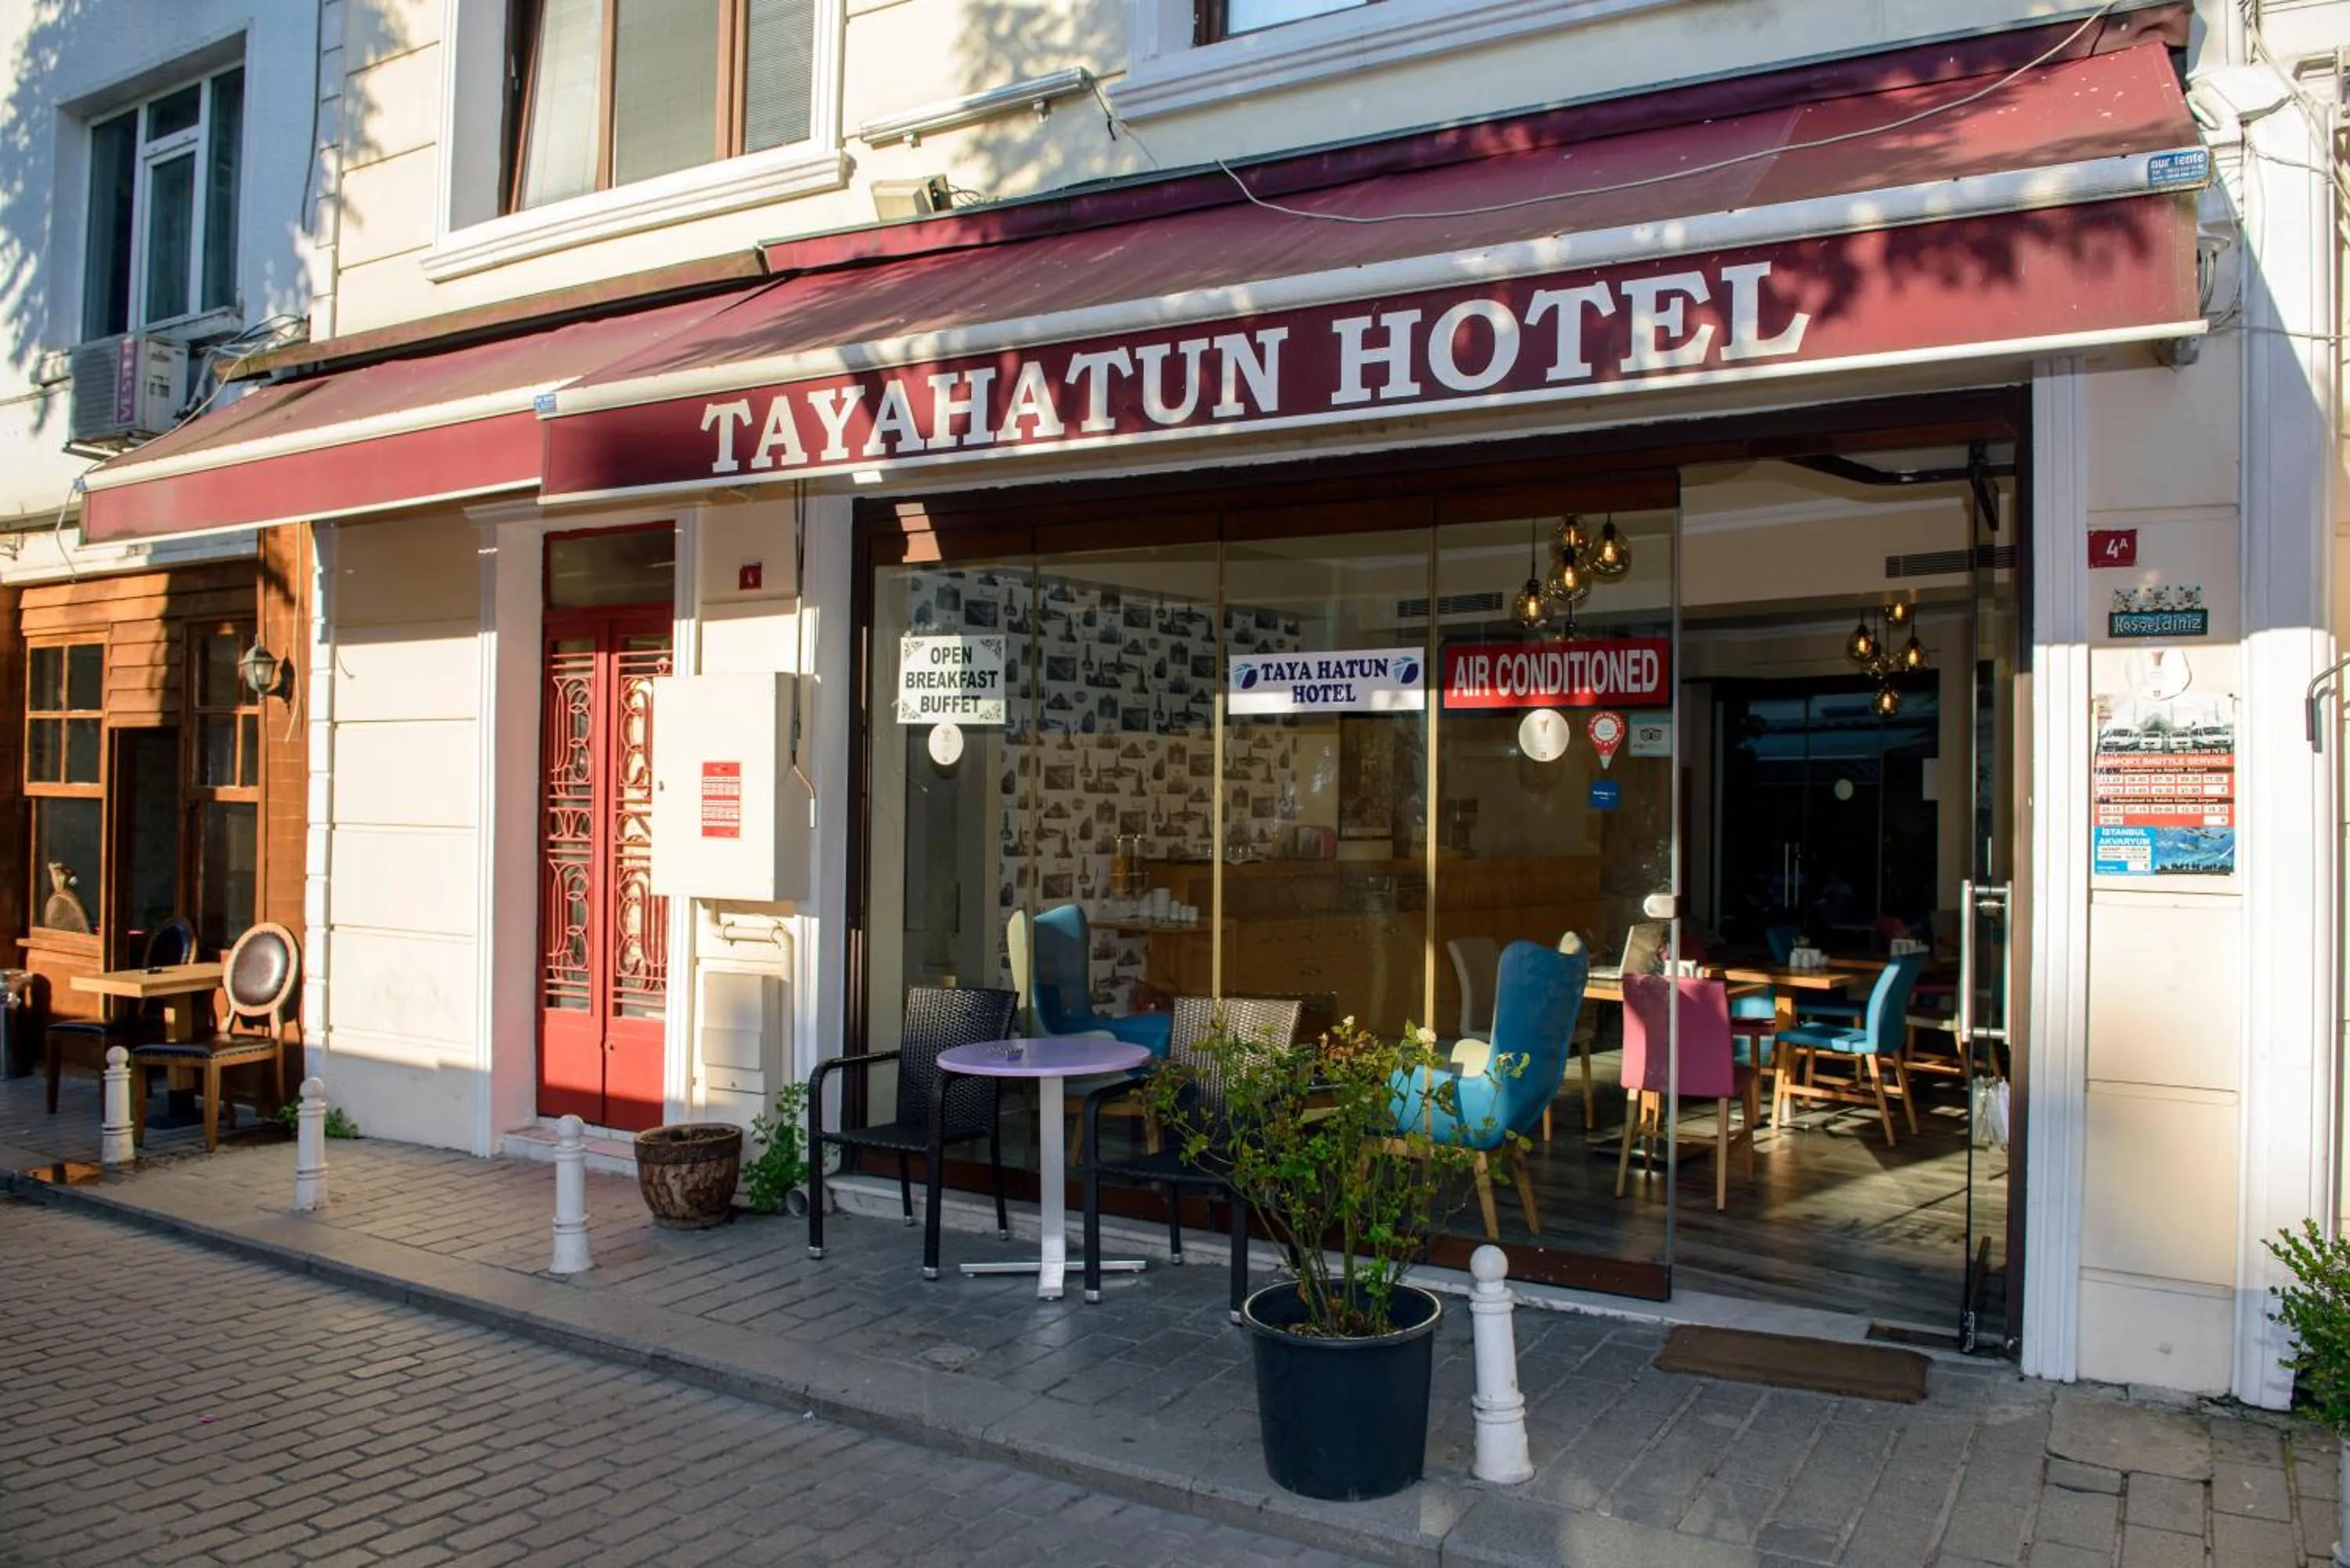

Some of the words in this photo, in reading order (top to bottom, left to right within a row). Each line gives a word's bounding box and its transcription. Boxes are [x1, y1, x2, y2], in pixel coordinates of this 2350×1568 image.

[700, 326, 1289, 474] TAYAHATUN
[1332, 261, 1811, 405] HOTEL
[2106, 538, 2128, 558] 4A
[931, 646, 972, 665] OPEN
[906, 670, 999, 688] BREAKFAST
[1261, 662, 1314, 681] TAYA
[1317, 658, 1389, 680] HATUN
[1453, 655, 1491, 698] AIR
[1496, 649, 1659, 696] CONDITIONED
[1292, 684, 1356, 703] HOTEL
[920, 695, 981, 713] BUFFET
